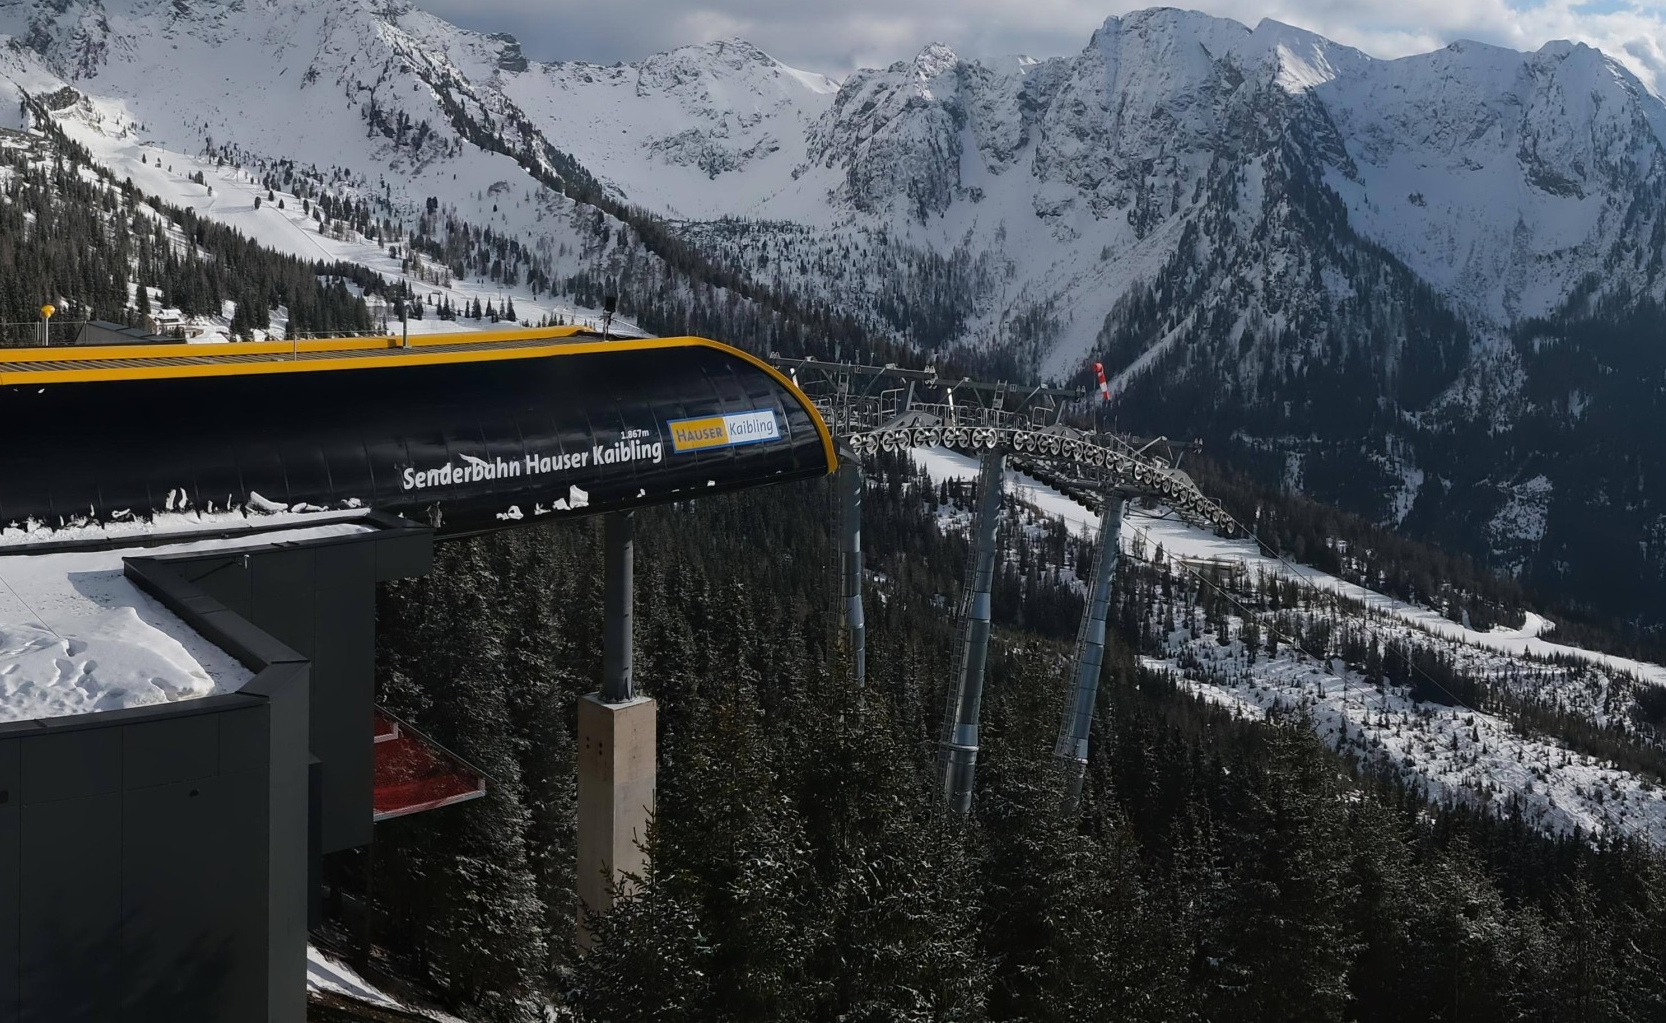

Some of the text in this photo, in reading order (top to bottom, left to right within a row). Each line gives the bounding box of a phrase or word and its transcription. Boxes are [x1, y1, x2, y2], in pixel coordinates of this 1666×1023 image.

[620, 429, 650, 440] 1.867m
[676, 419, 774, 443] HAUSER Kaibling
[403, 440, 662, 490] Senderbahn Hauser Kaibling
